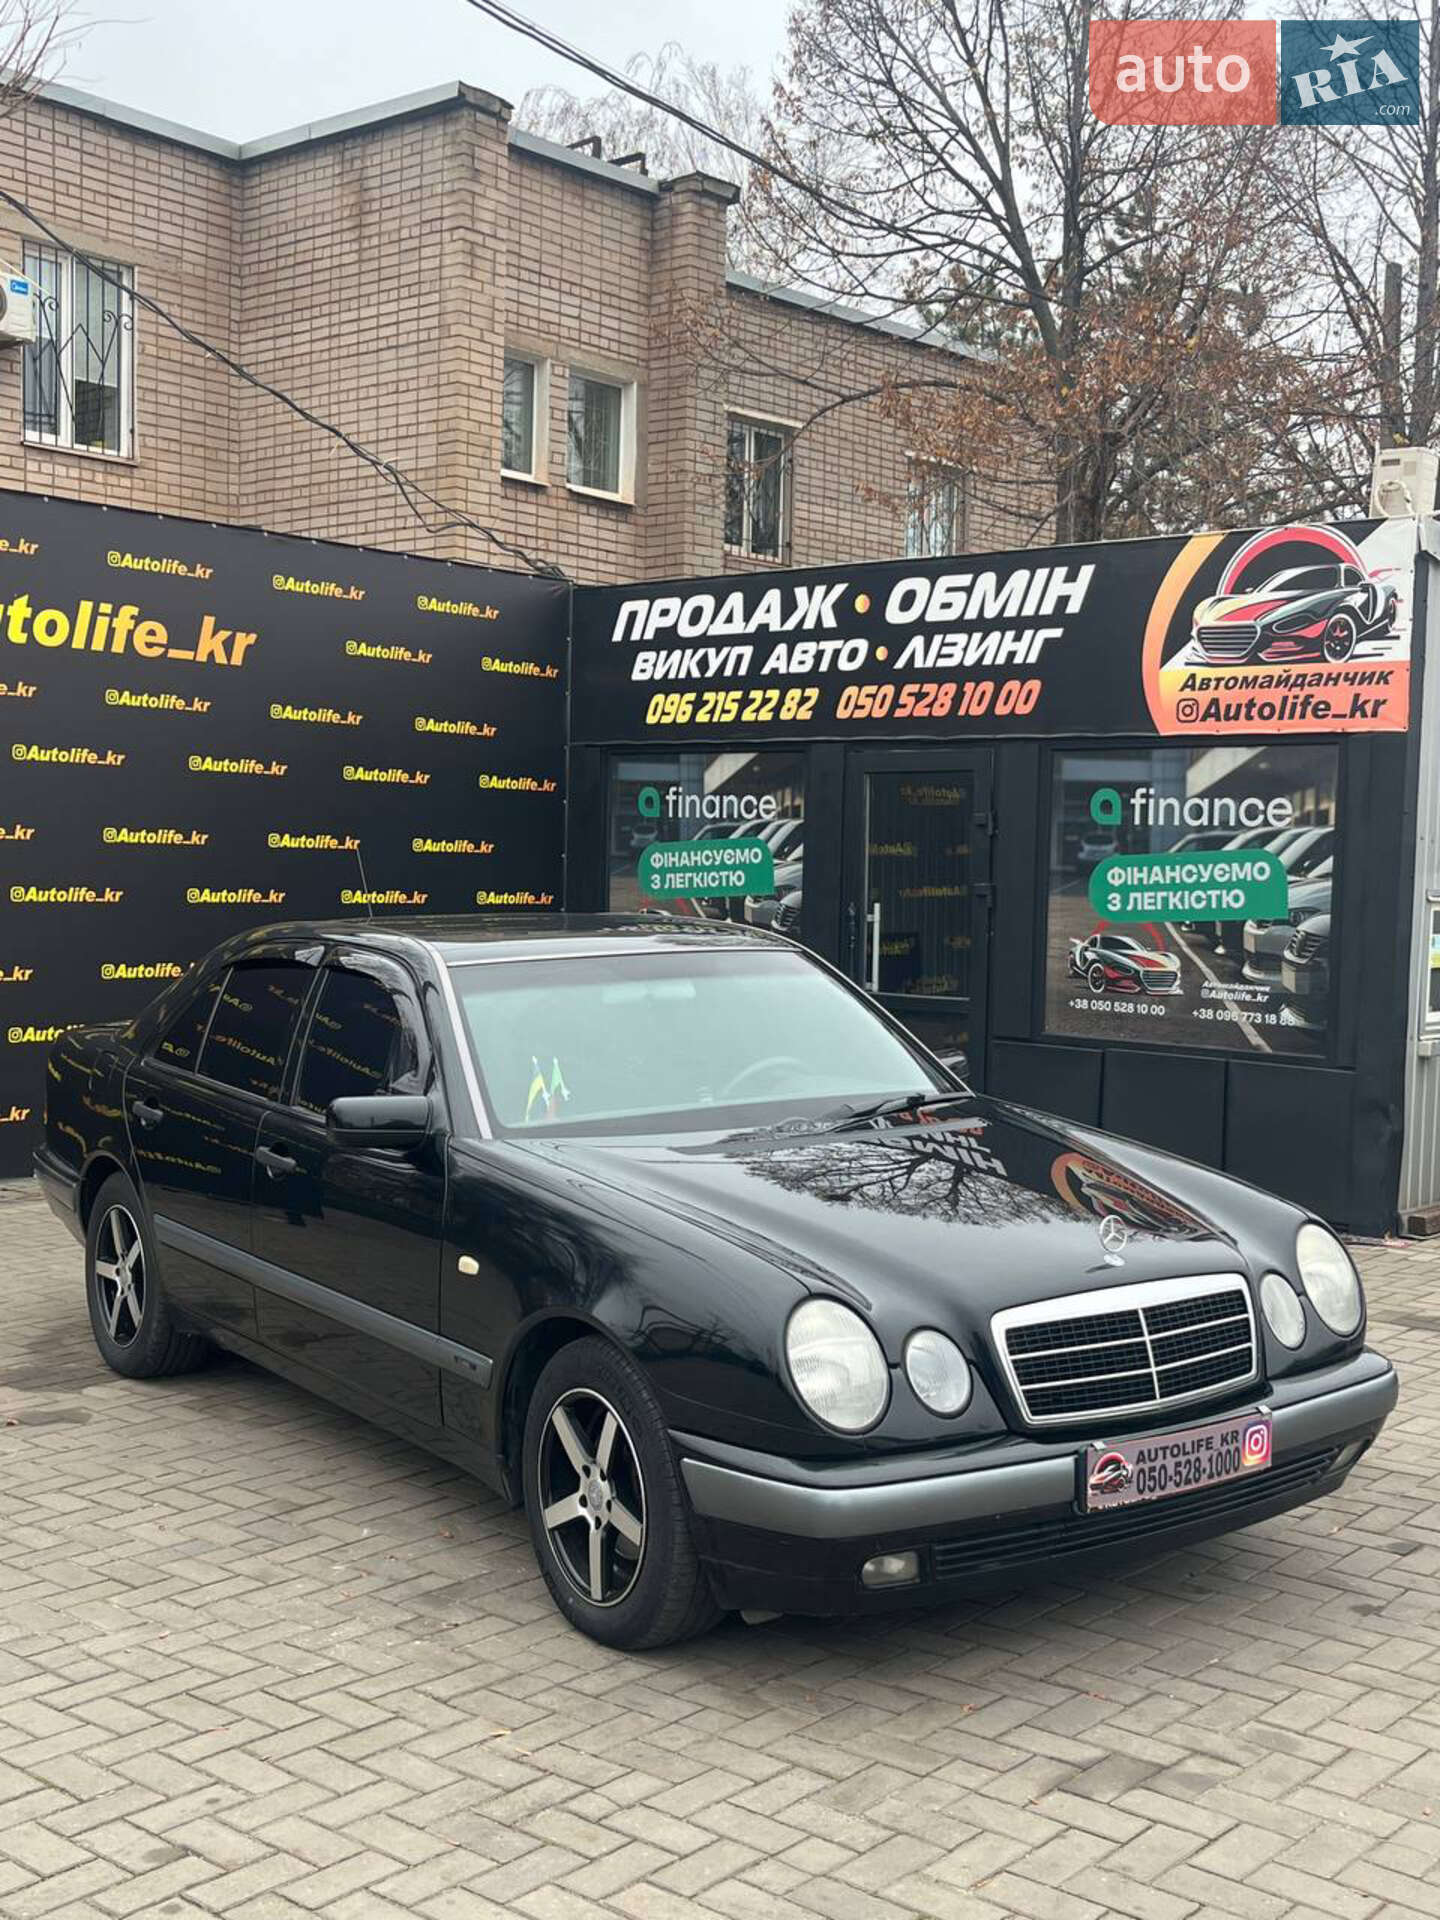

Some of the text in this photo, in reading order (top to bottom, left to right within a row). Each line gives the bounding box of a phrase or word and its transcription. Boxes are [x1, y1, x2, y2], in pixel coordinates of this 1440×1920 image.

[611, 564, 1097, 642] ПРОДАЖ ОБМІН
[631, 628, 1064, 681] ВИКУП АВТО ЛІЗИНГ
[1179, 669, 1394, 692] Автомайданчик
[645, 679, 1042, 724] 096 215 22 82 050 528 10 00
[665, 786, 777, 820] finance
[1130, 787, 1293, 828] finance
[650, 847, 763, 869] ФІНАНСУЄМО
[663, 871, 745, 889] ЛЕГКІСТЮ
[1106, 861, 1271, 887] ФІНАНСУЄМО
[1126, 889, 1245, 911] ЛЕГКІСТЮ
[1069, 998, 1165, 1016] +38 050 528 10 00
[1192, 1008, 1213, 1019] +38
[1241, 1011, 1262, 1023] 773
[1265, 1013, 1277, 1024] 18
[1136, 1449, 1241, 1495] 050-528-1000
